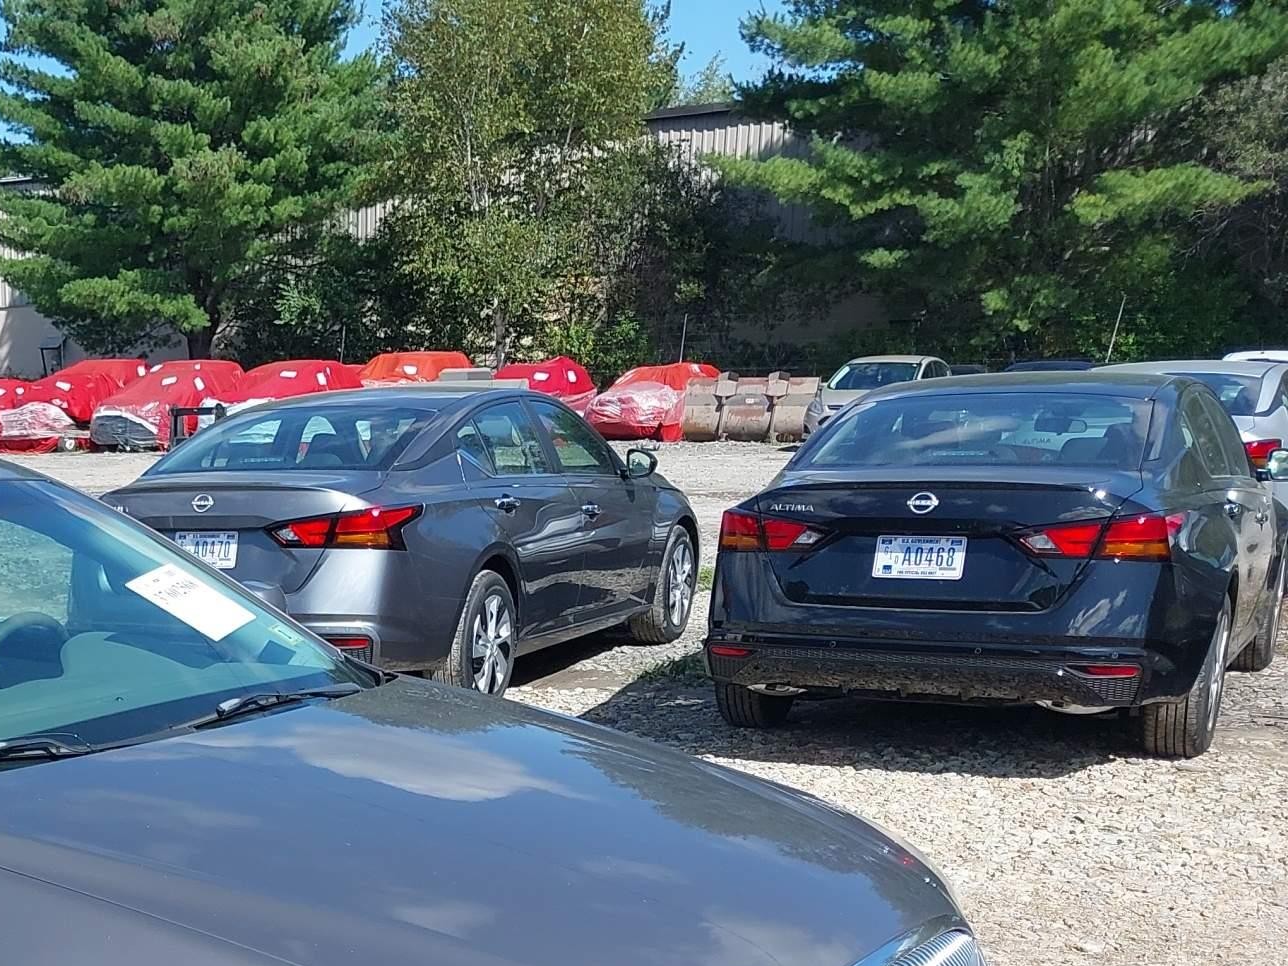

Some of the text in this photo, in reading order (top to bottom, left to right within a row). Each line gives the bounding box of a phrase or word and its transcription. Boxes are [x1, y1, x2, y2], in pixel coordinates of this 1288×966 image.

[769, 503, 815, 513] ALTIMA
[193, 540, 231, 558] A0470
[901, 546, 956, 567] A0468
